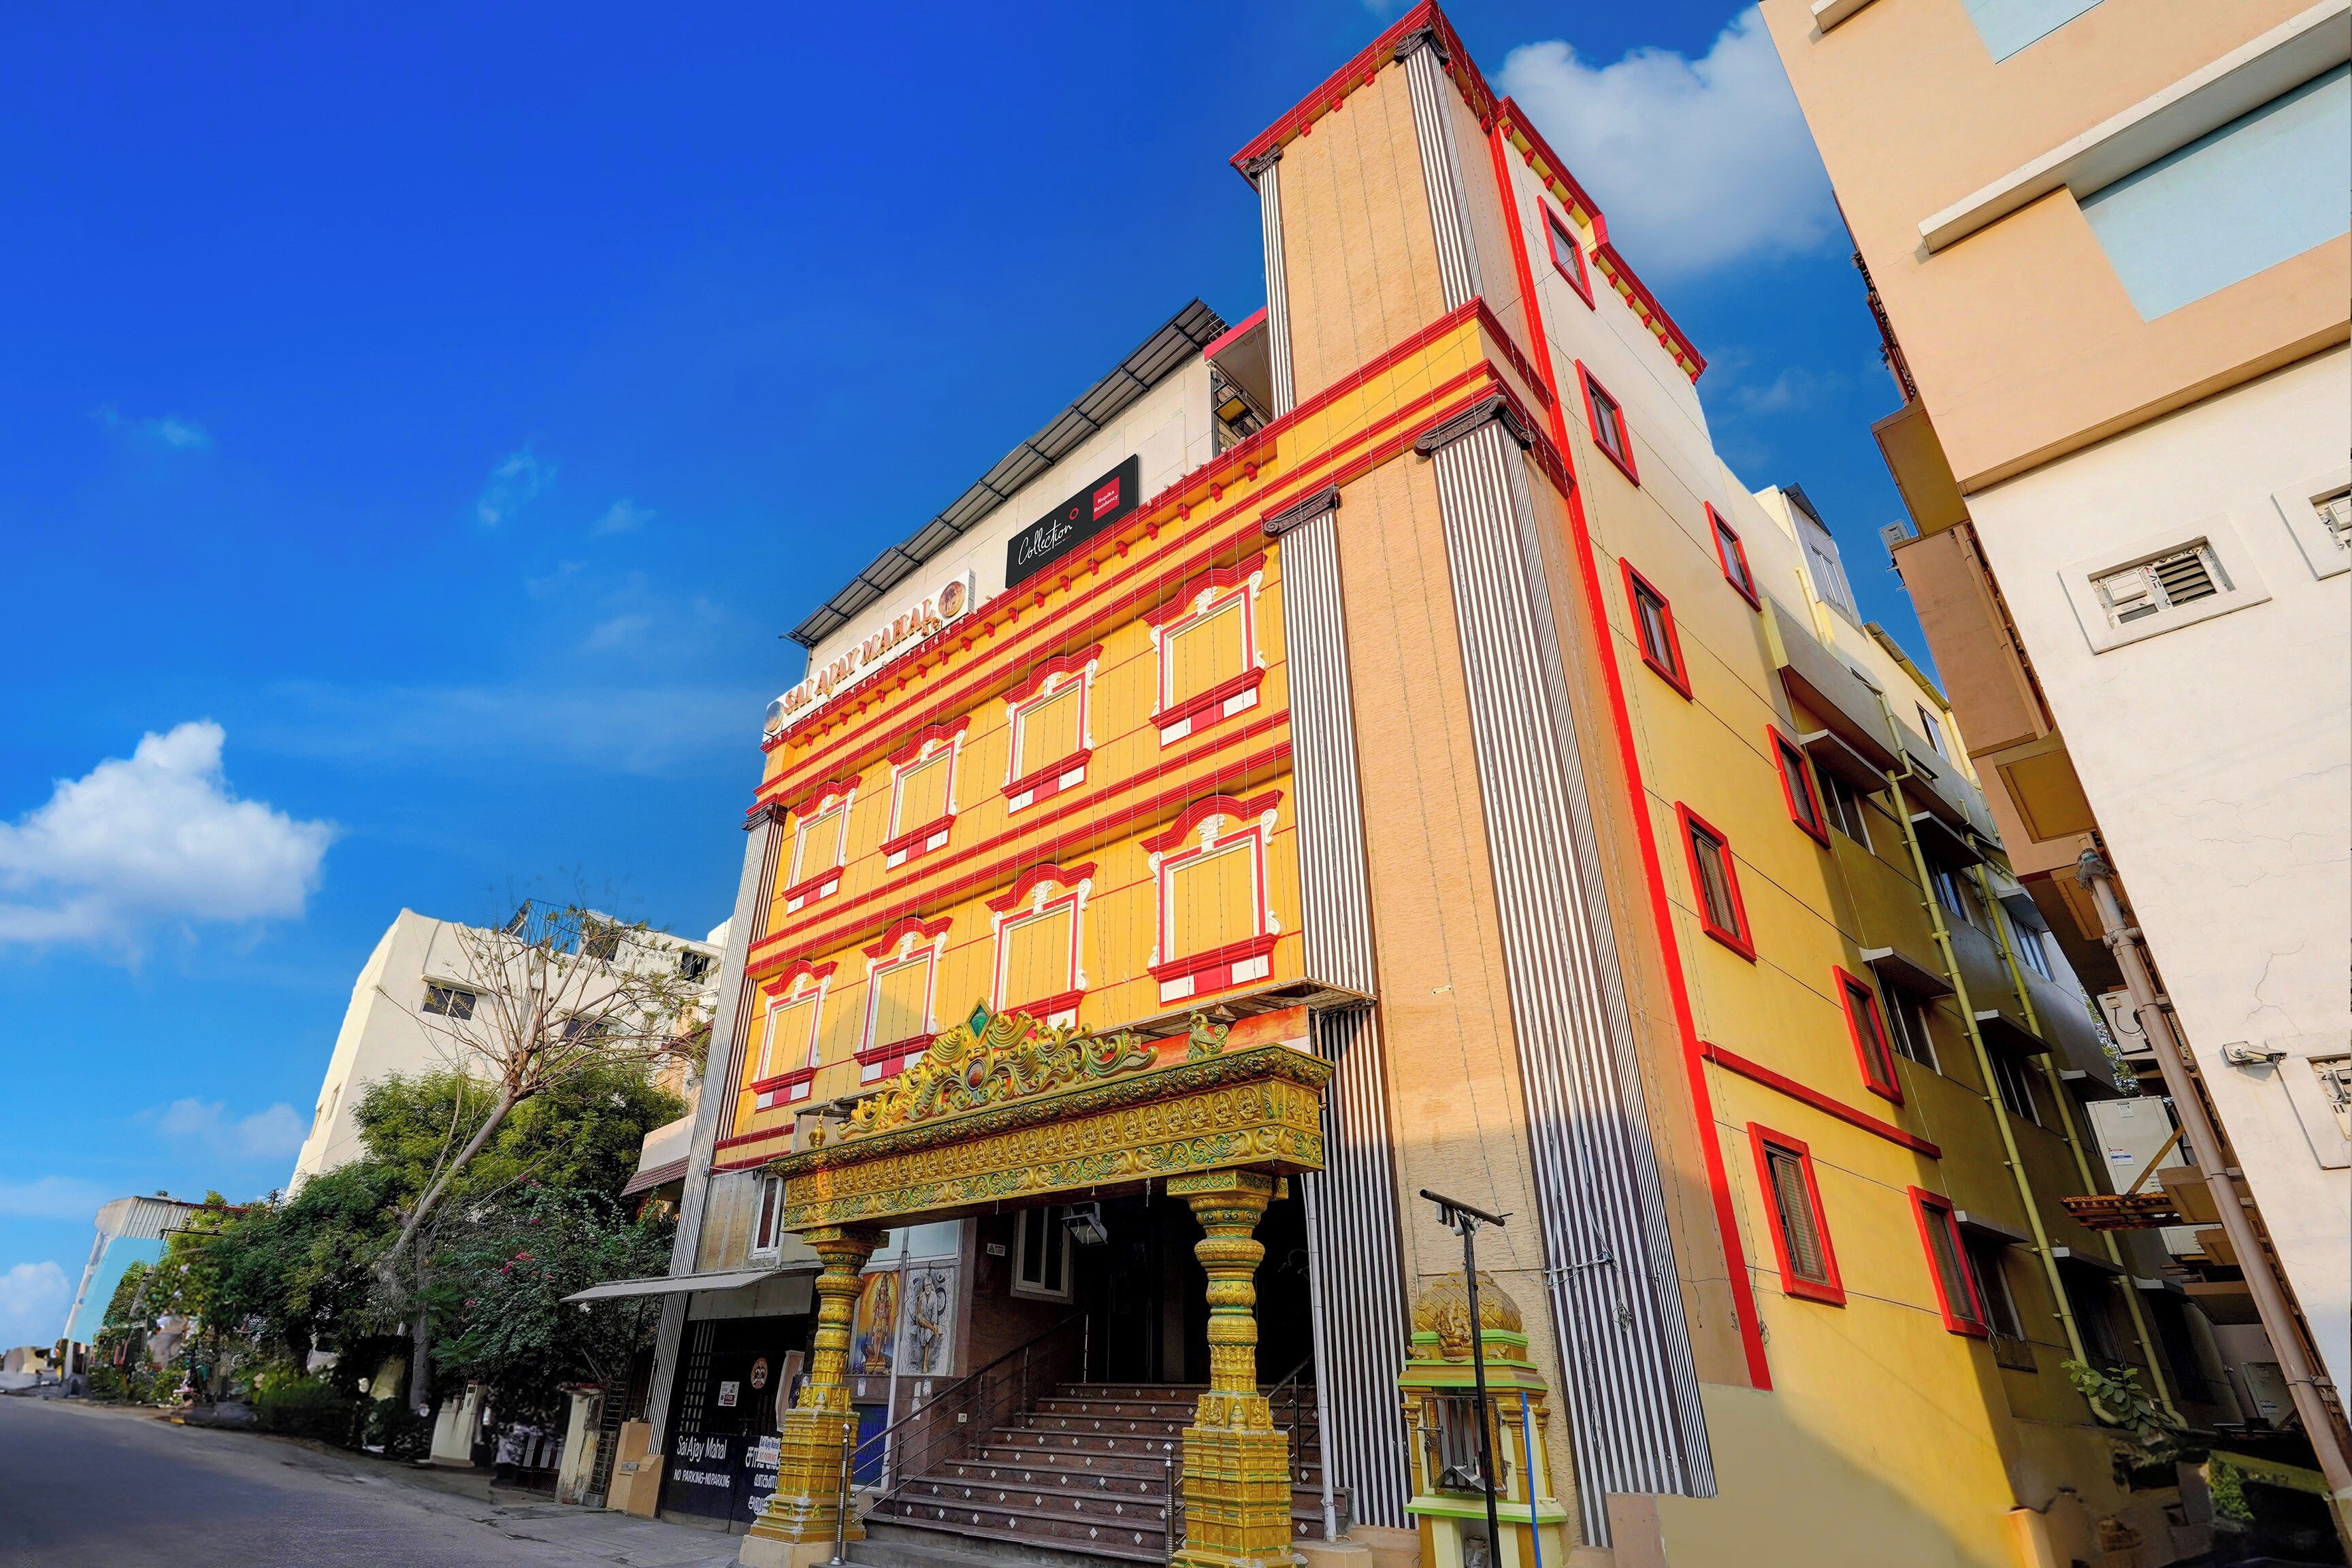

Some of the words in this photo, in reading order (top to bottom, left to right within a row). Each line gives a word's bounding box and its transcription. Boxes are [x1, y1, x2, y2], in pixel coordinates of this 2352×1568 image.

[1094, 494, 1118, 512] Residency
[1098, 490, 1115, 504] Rupika
[1018, 519, 1073, 565] Collection
[784, 678, 813, 715] SAI
[814, 647, 860, 696] AJAY
[860, 598, 936, 666] MAHAL
[677, 1435, 688, 1456] Sai
[687, 1435, 705, 1463] Ajay
[705, 1437, 728, 1460] Mahal
[673, 1469, 681, 1482] NO
